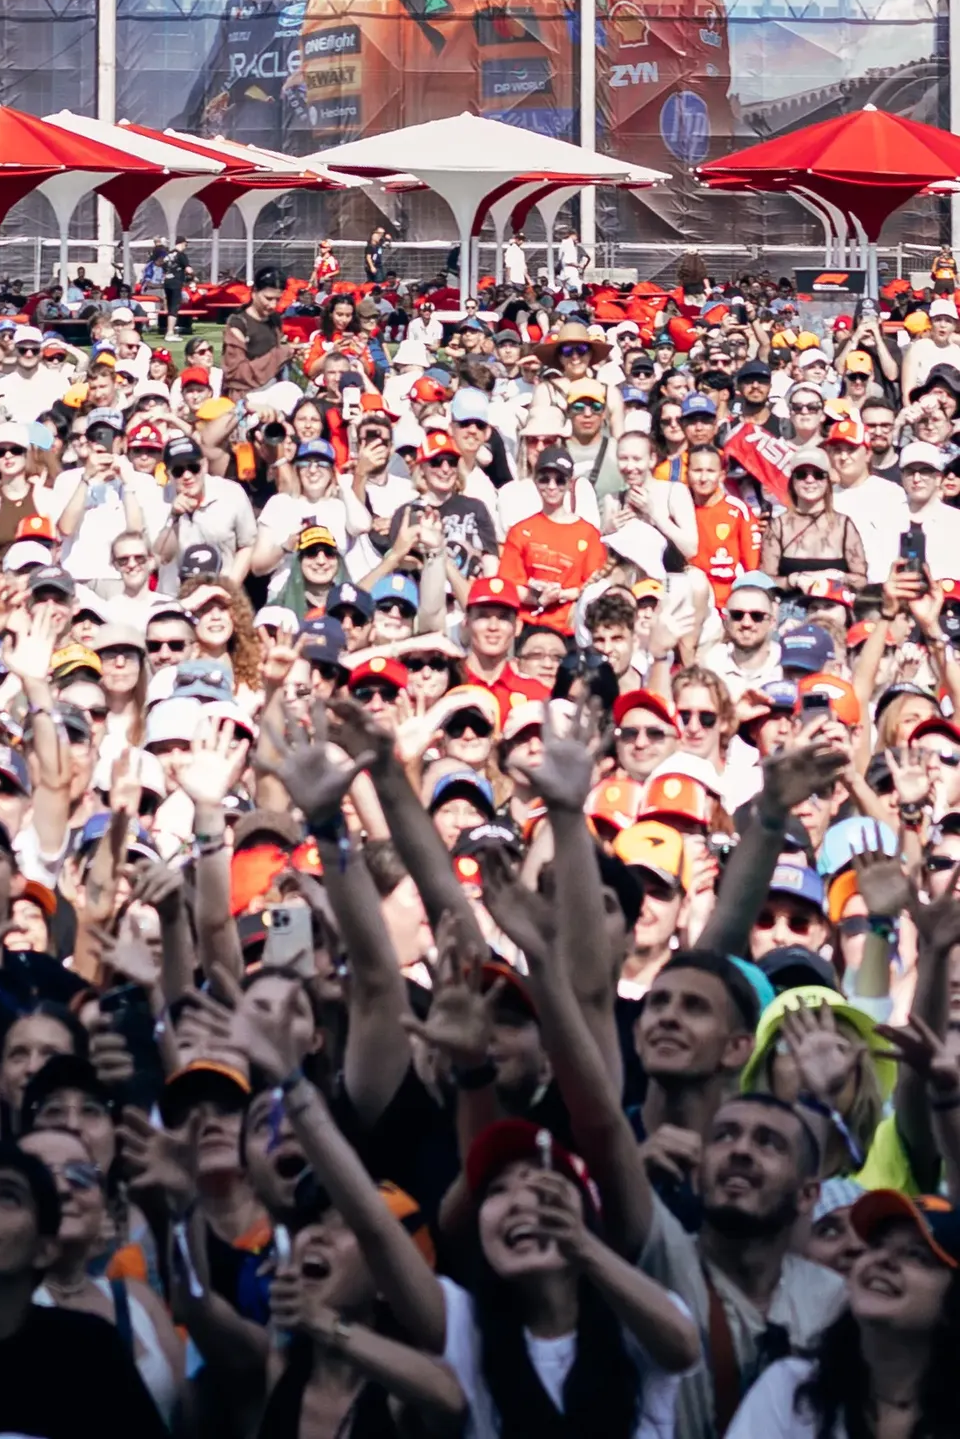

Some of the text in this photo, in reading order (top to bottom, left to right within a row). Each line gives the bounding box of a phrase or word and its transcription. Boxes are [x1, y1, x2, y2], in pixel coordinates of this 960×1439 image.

[229, 50, 301, 78] RACLE
[609, 61, 659, 87] ZYN
[494, 83, 511, 93] DP
